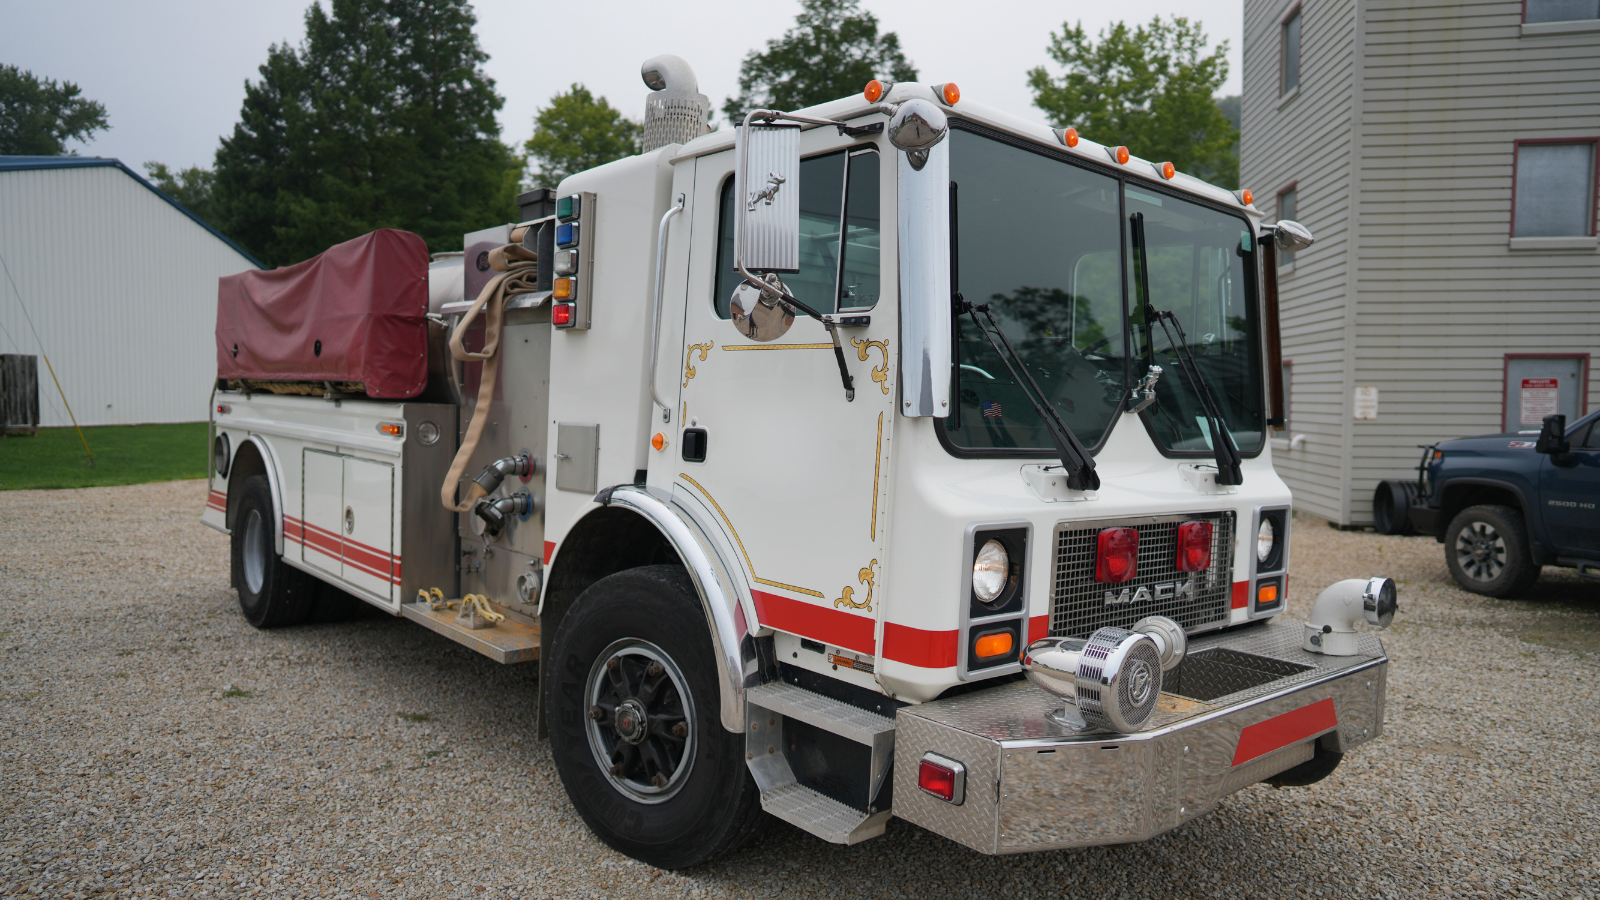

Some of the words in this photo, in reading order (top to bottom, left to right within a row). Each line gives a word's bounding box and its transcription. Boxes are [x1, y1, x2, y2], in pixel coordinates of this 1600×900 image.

[1548, 500, 1577, 508] 2500
[1104, 579, 1194, 608] MACK
[559, 652, 645, 835] GOODYEAR
